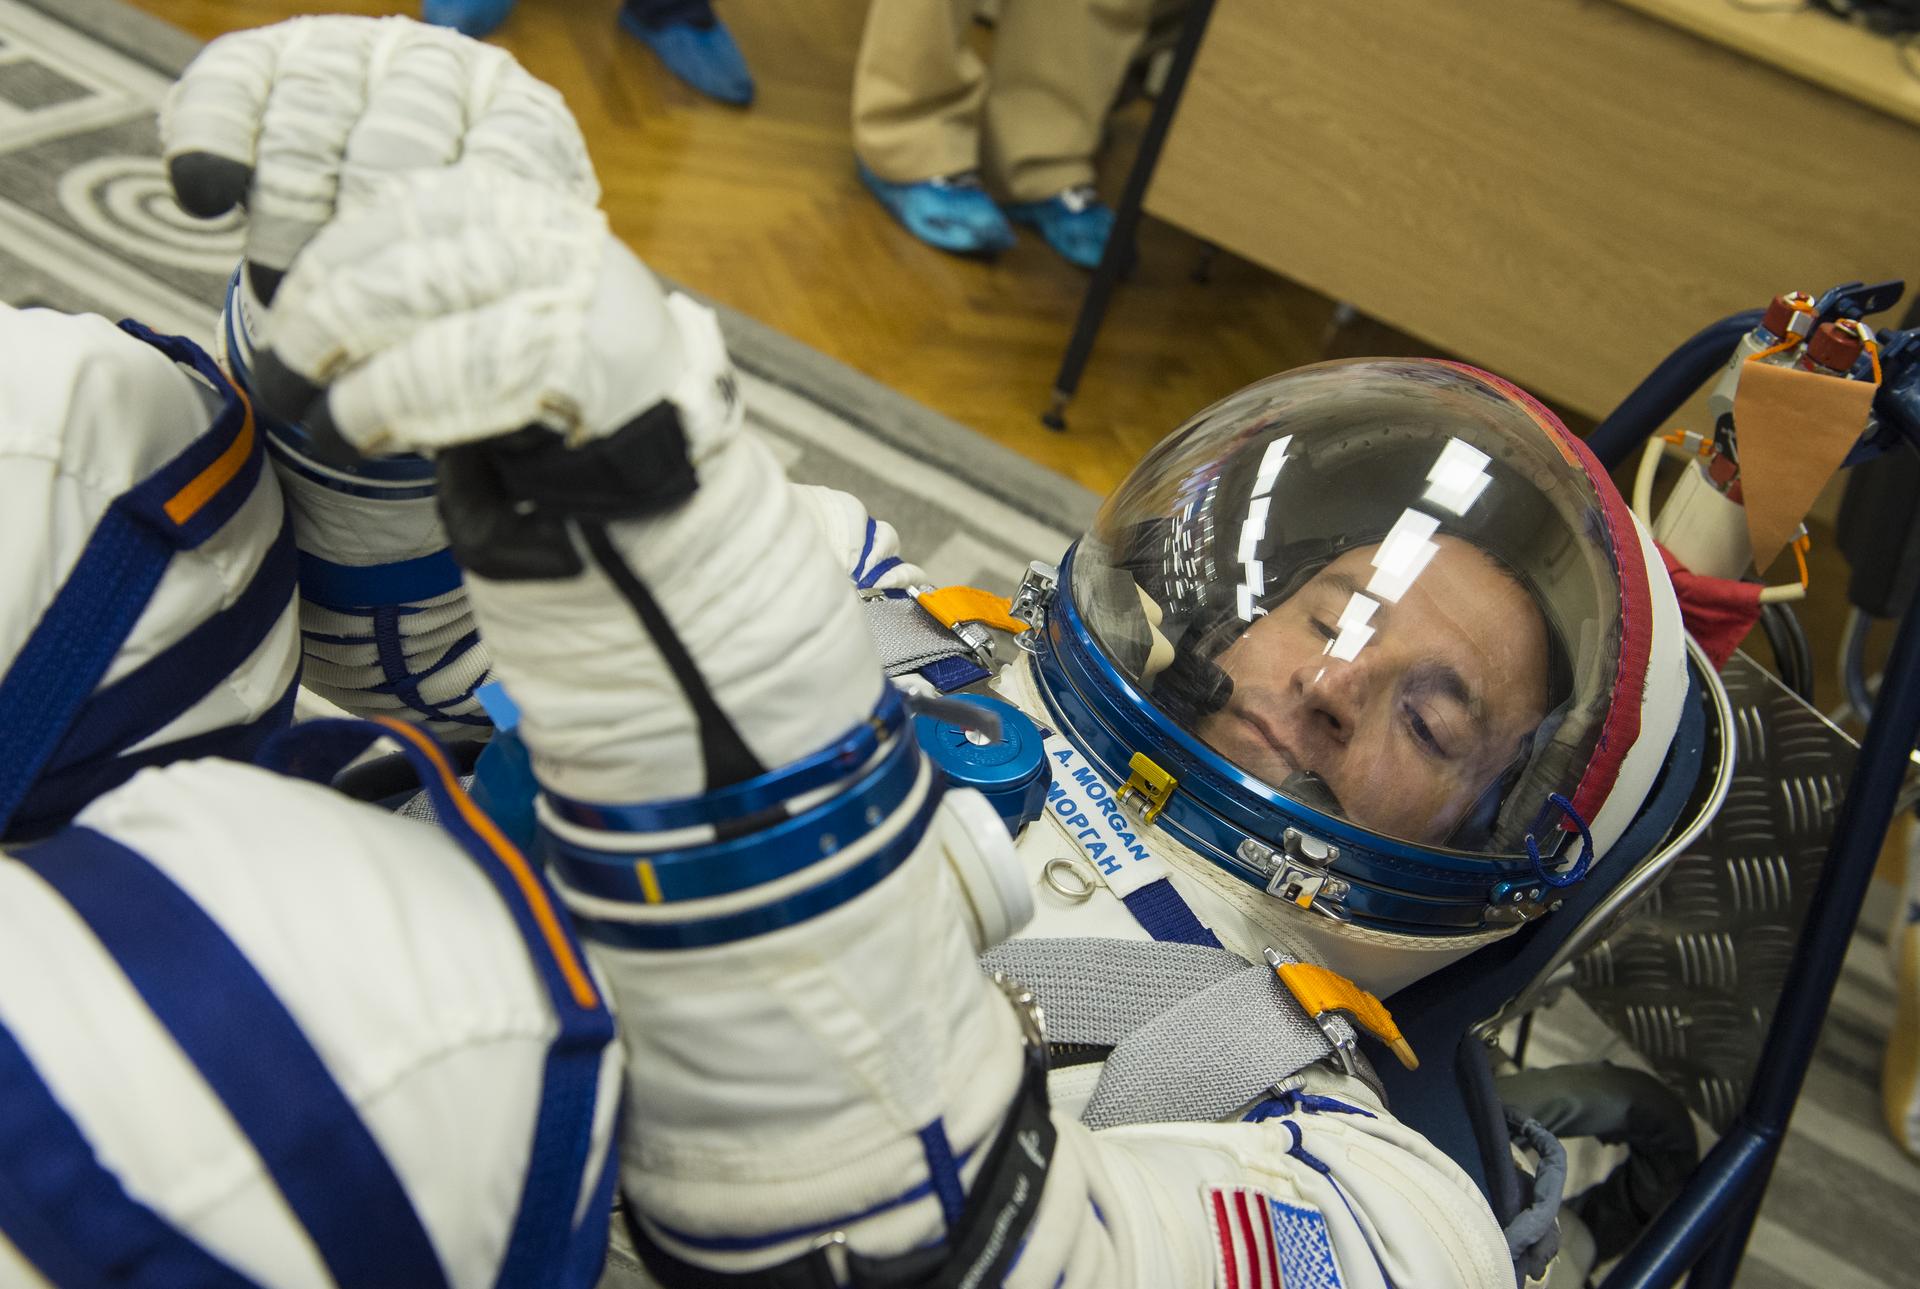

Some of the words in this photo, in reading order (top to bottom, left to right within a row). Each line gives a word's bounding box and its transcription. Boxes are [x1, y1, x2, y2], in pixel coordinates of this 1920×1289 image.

[1047, 780, 1123, 876] МОРГАН
[1053, 750, 1074, 768] A.
[1072, 766, 1150, 862] MORGAN
